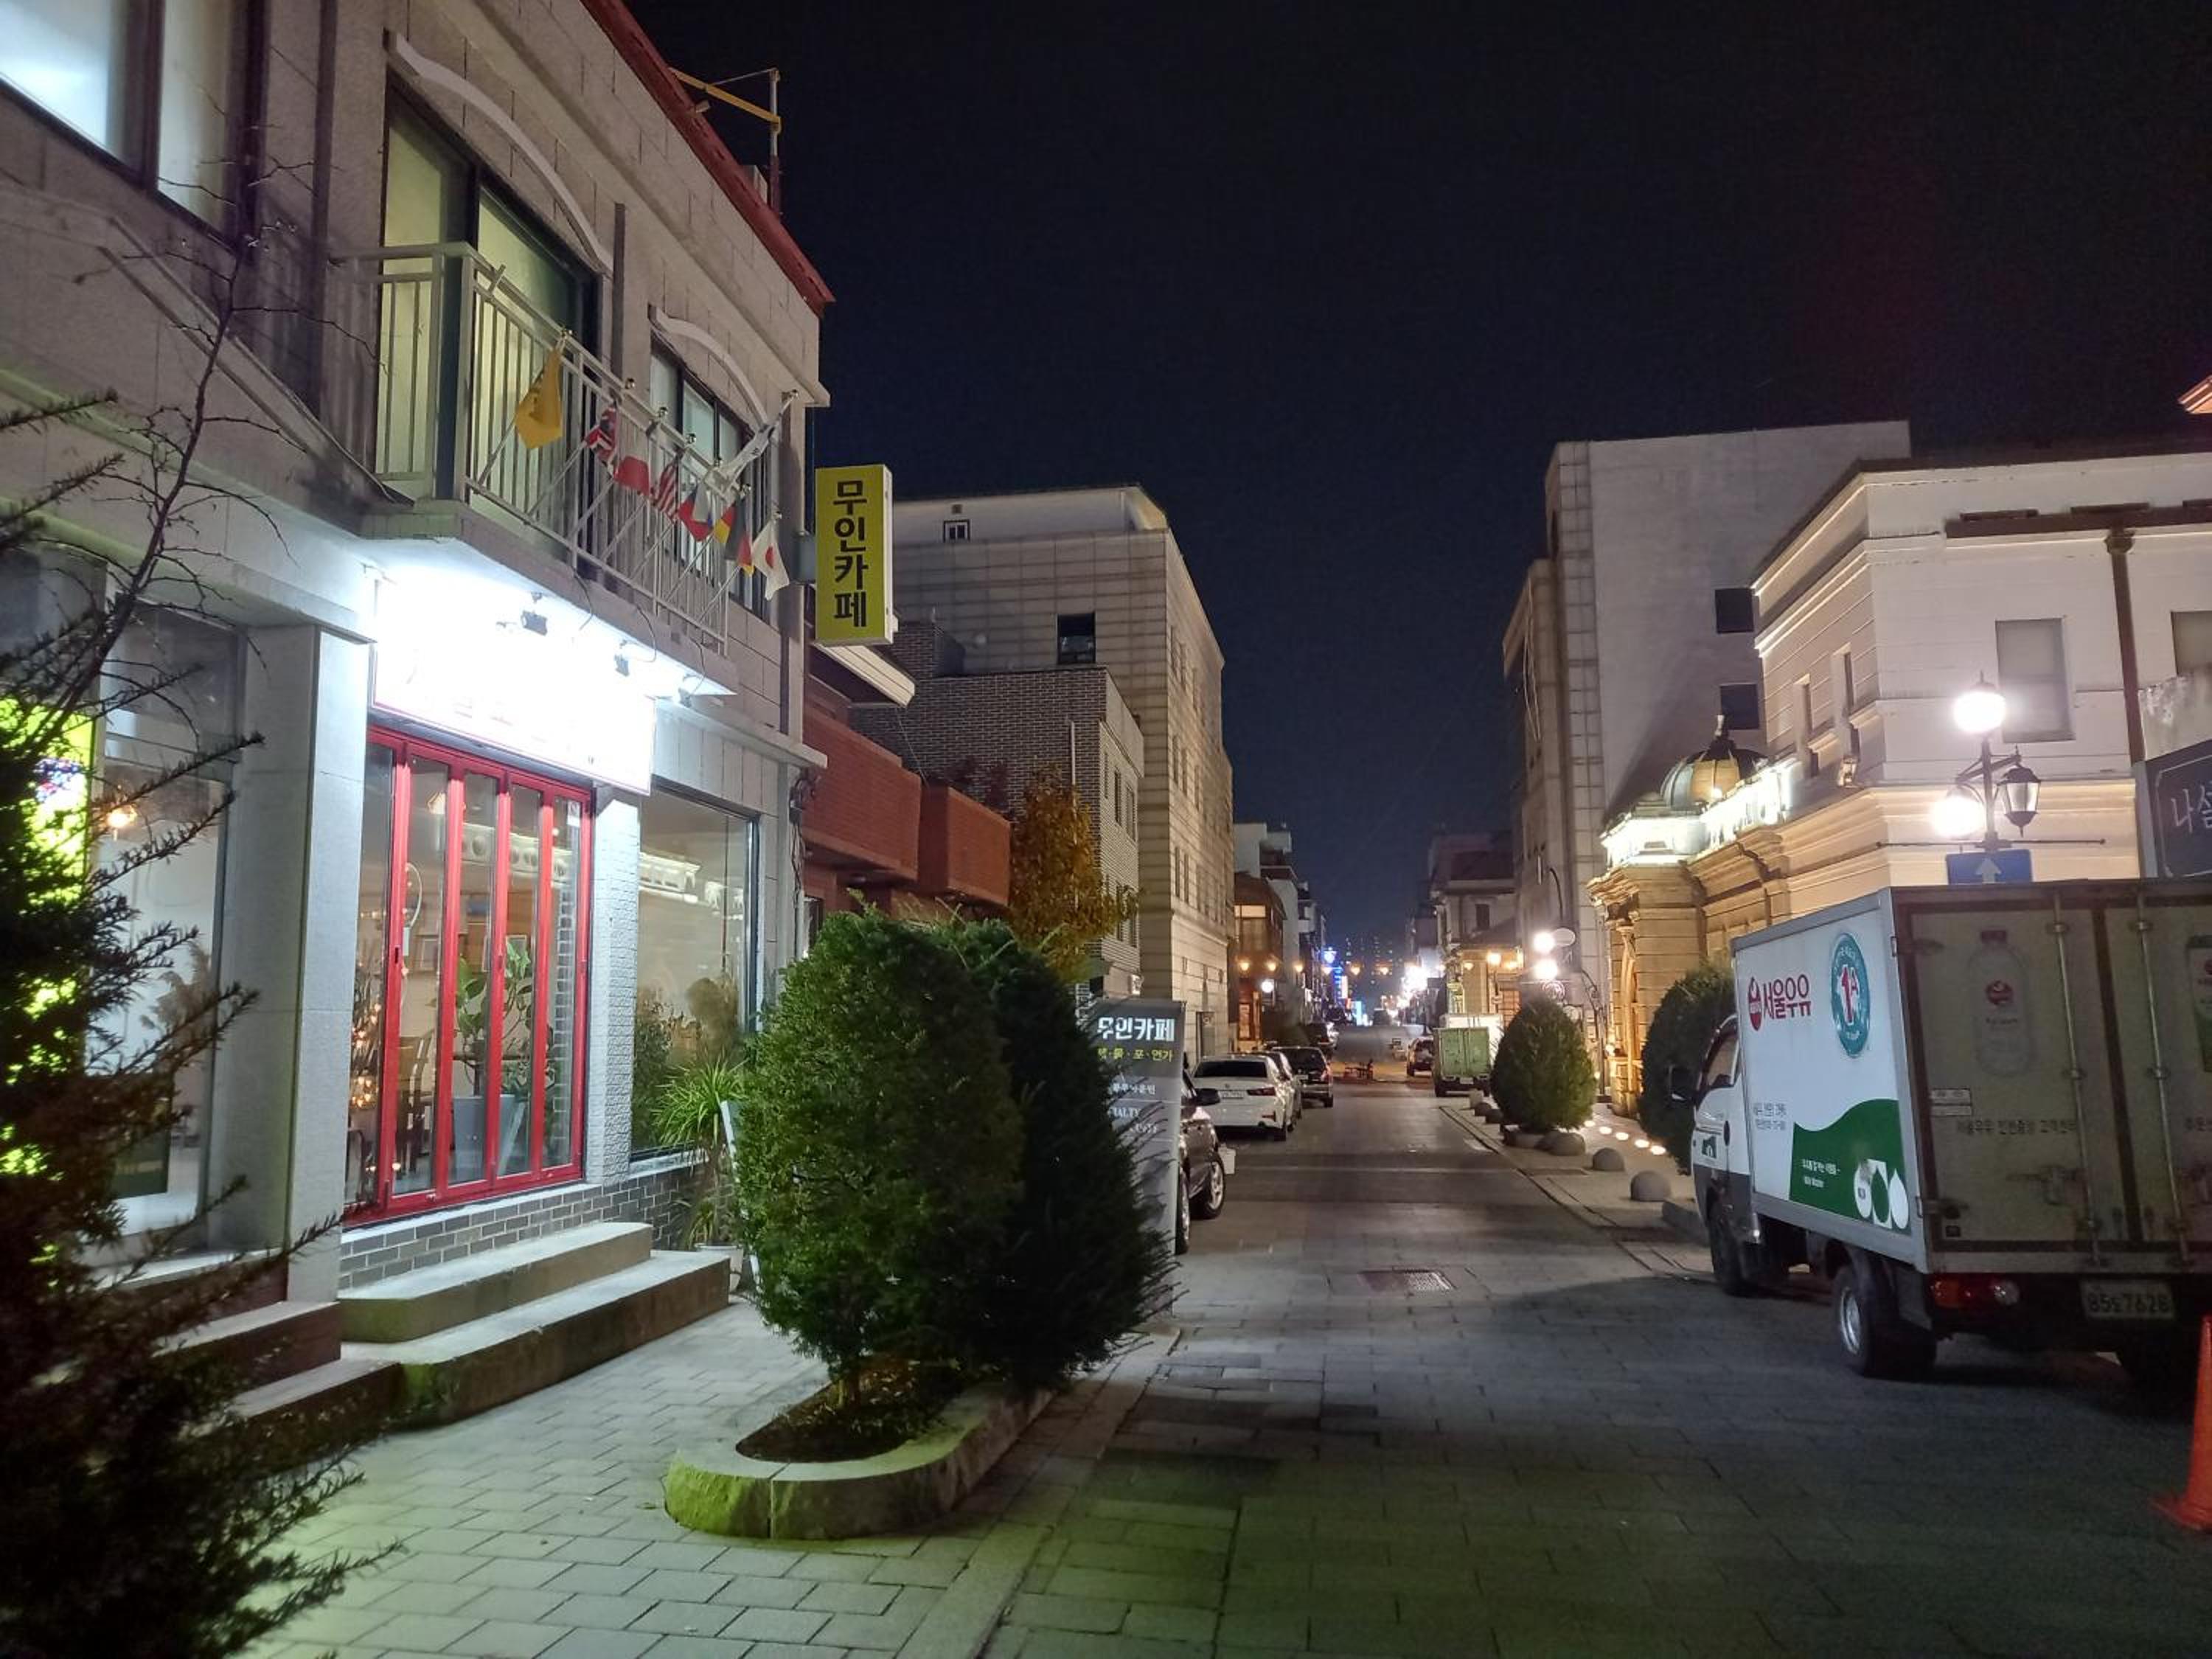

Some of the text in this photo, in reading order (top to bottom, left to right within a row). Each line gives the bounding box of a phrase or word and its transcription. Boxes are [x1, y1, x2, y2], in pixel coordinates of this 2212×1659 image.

[832, 480, 869, 627] 무인카페
[1763, 974, 1812, 1020] 서울우유
[1097, 1016, 1175, 1041] 무인카페
